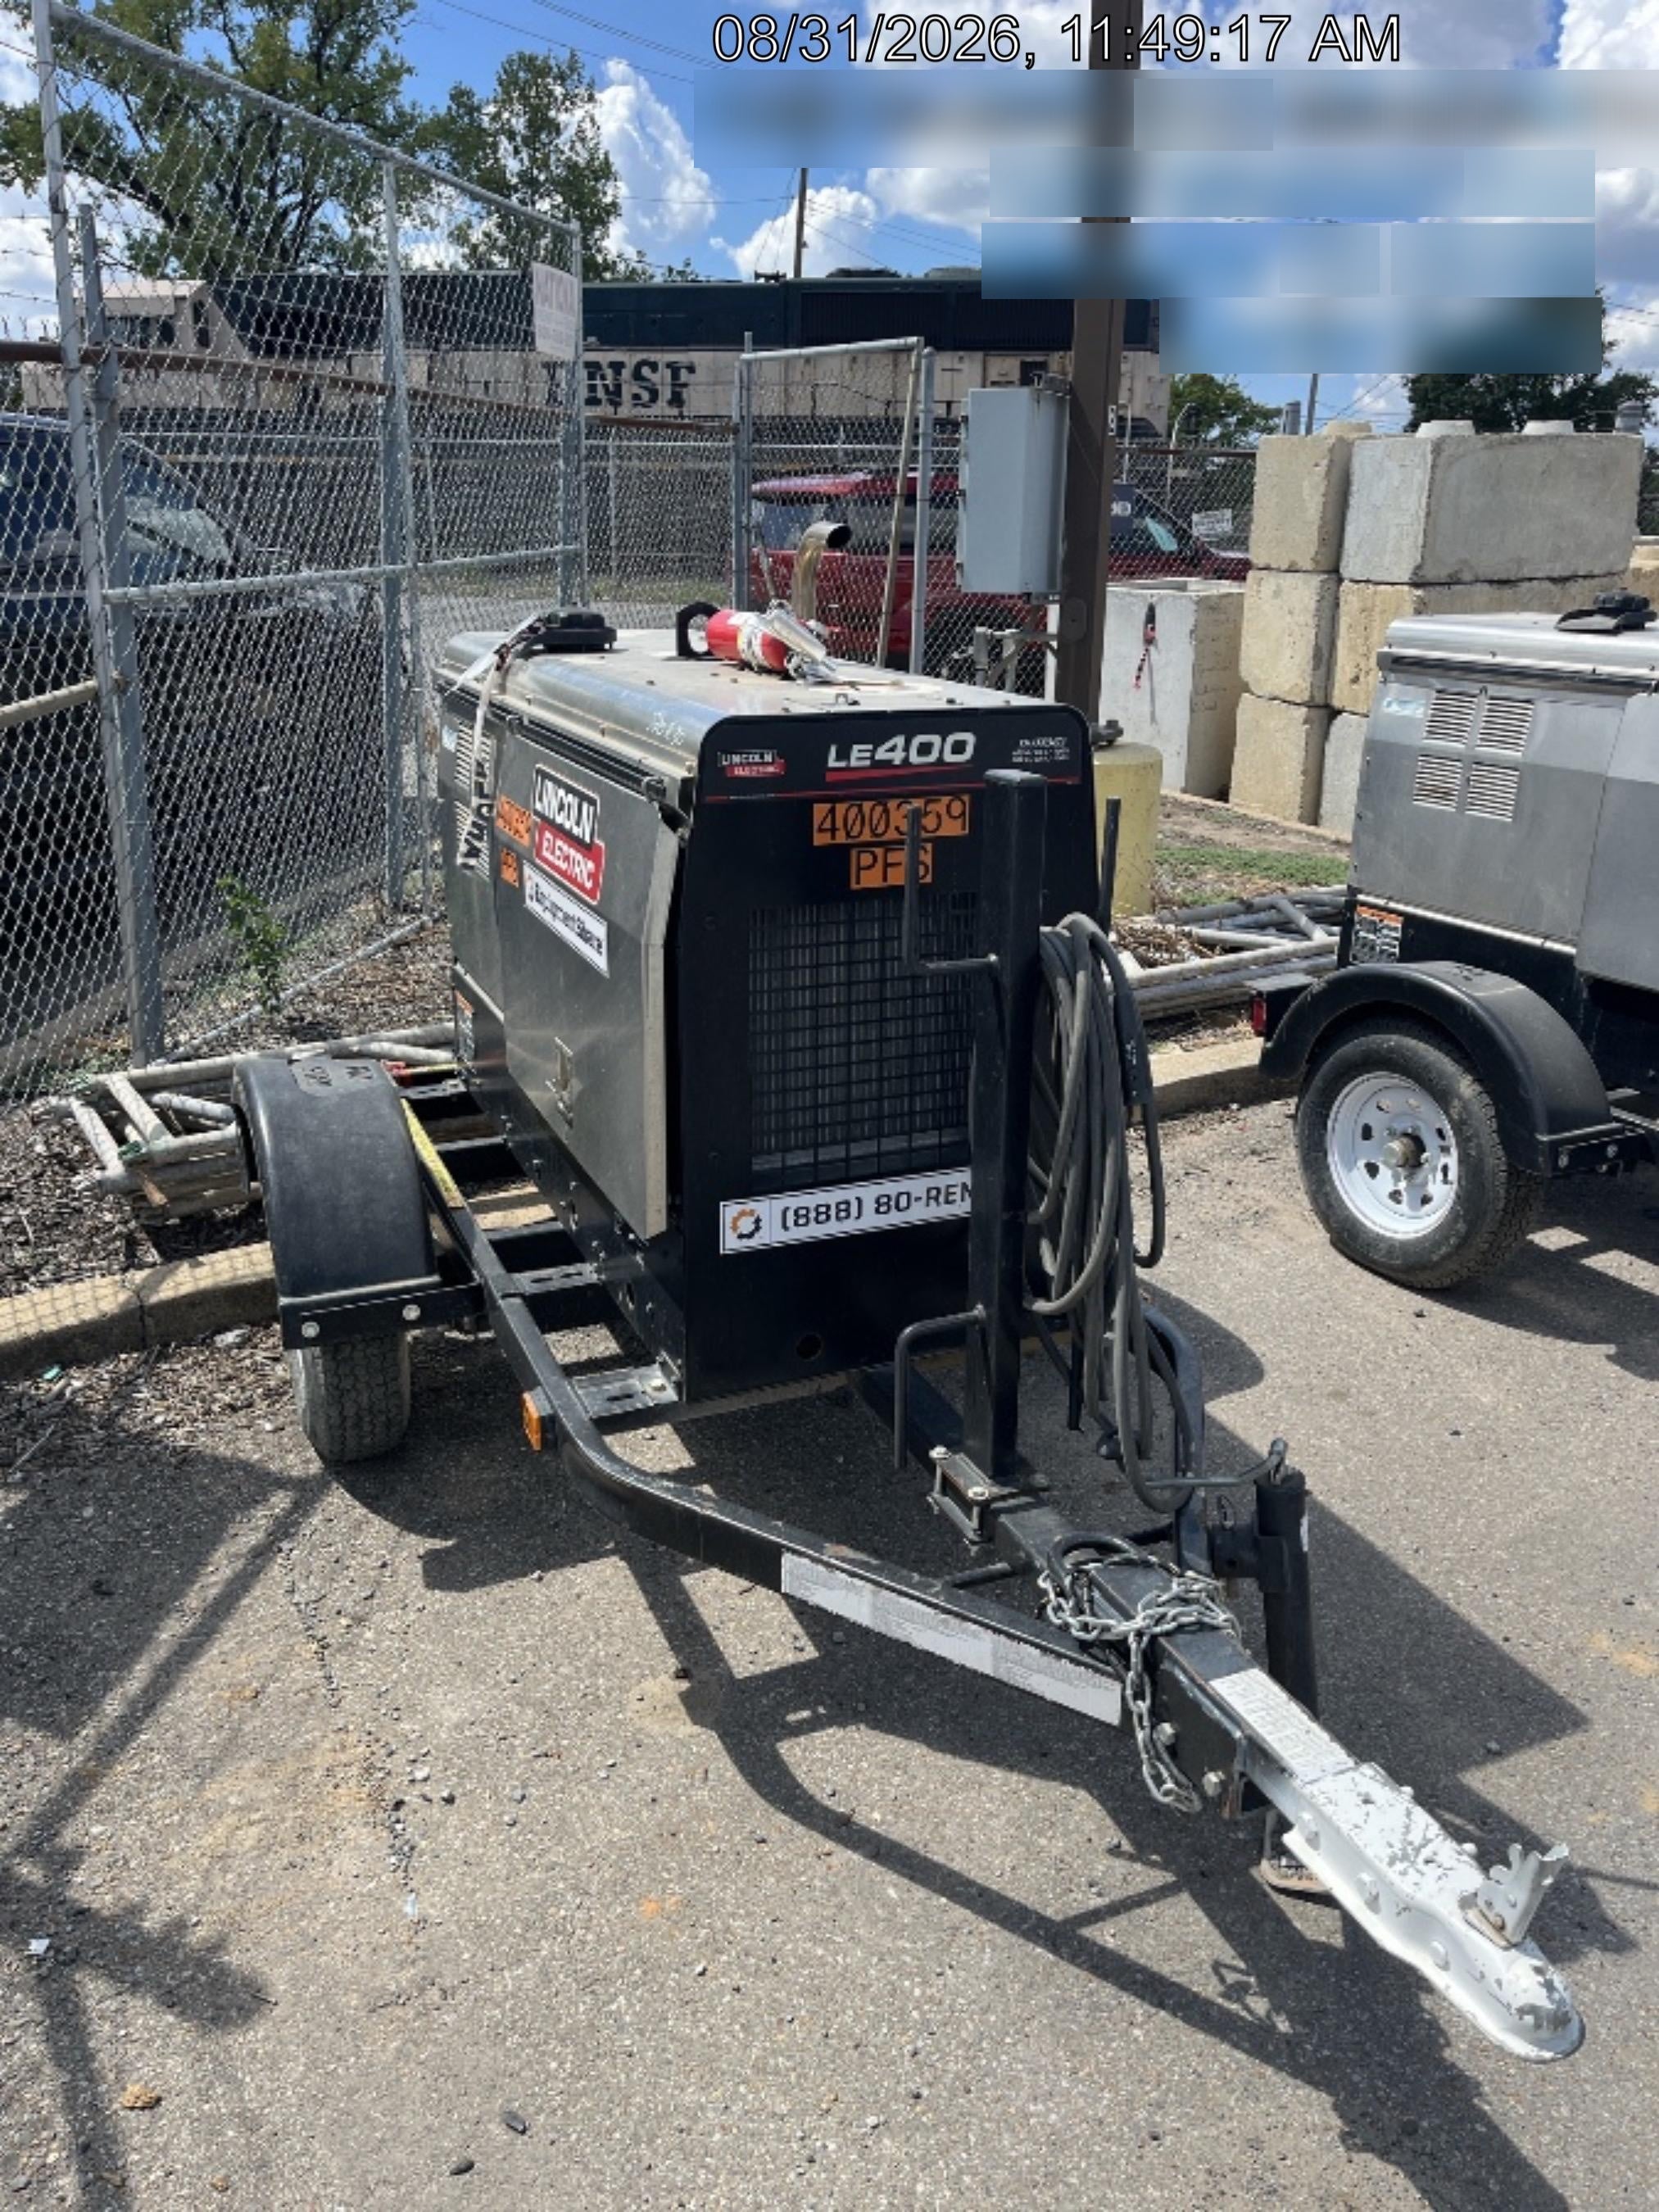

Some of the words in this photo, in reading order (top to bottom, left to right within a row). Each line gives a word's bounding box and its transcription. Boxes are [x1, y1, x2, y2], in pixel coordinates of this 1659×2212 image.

[827, 731, 976, 768] LE400
[535, 774, 595, 844] LINCOLN
[816, 796, 967, 841] 400359
[542, 830, 596, 889] ELECTRIC
[781, 1196, 862, 1231] (888)
